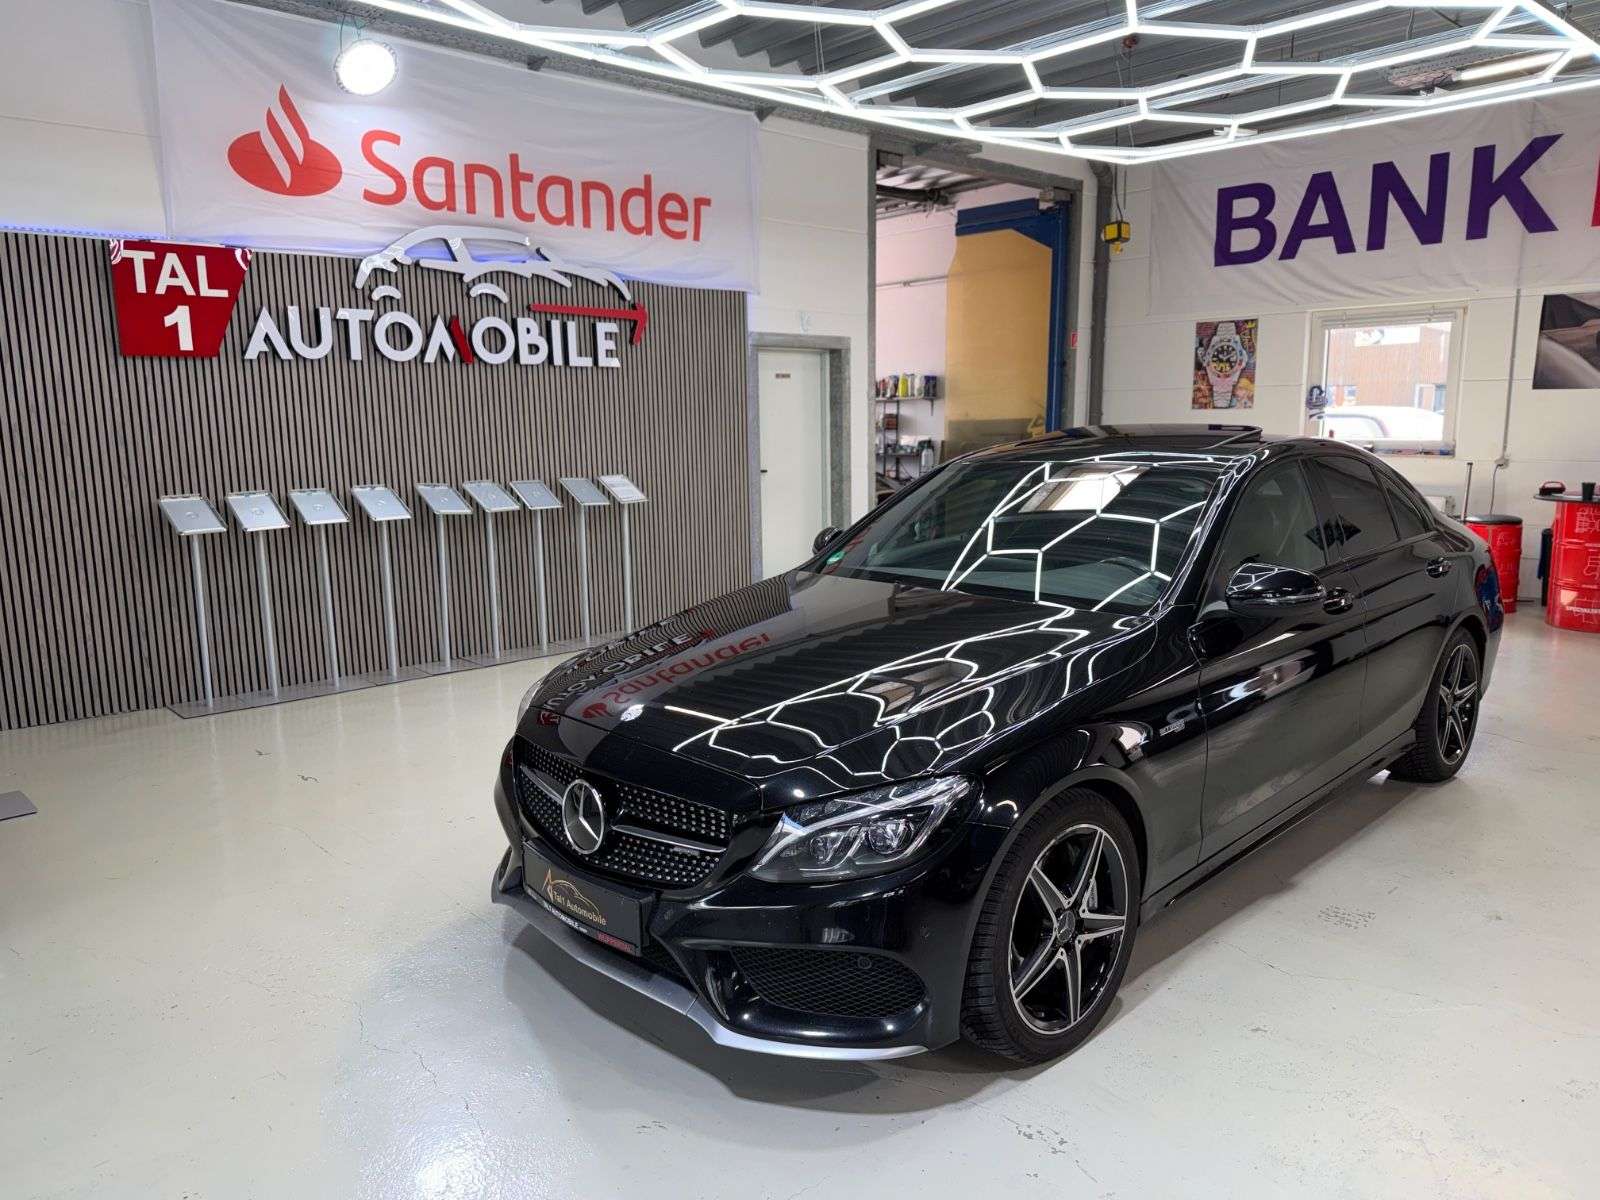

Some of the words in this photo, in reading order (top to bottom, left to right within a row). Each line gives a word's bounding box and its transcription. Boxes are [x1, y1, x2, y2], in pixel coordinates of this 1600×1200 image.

[360, 129, 712, 243] Santander
[1213, 133, 1565, 268] BANK
[120, 248, 230, 298] TAL
[163, 304, 195, 352] 1
[243, 305, 622, 369] AUTOMOBILE
